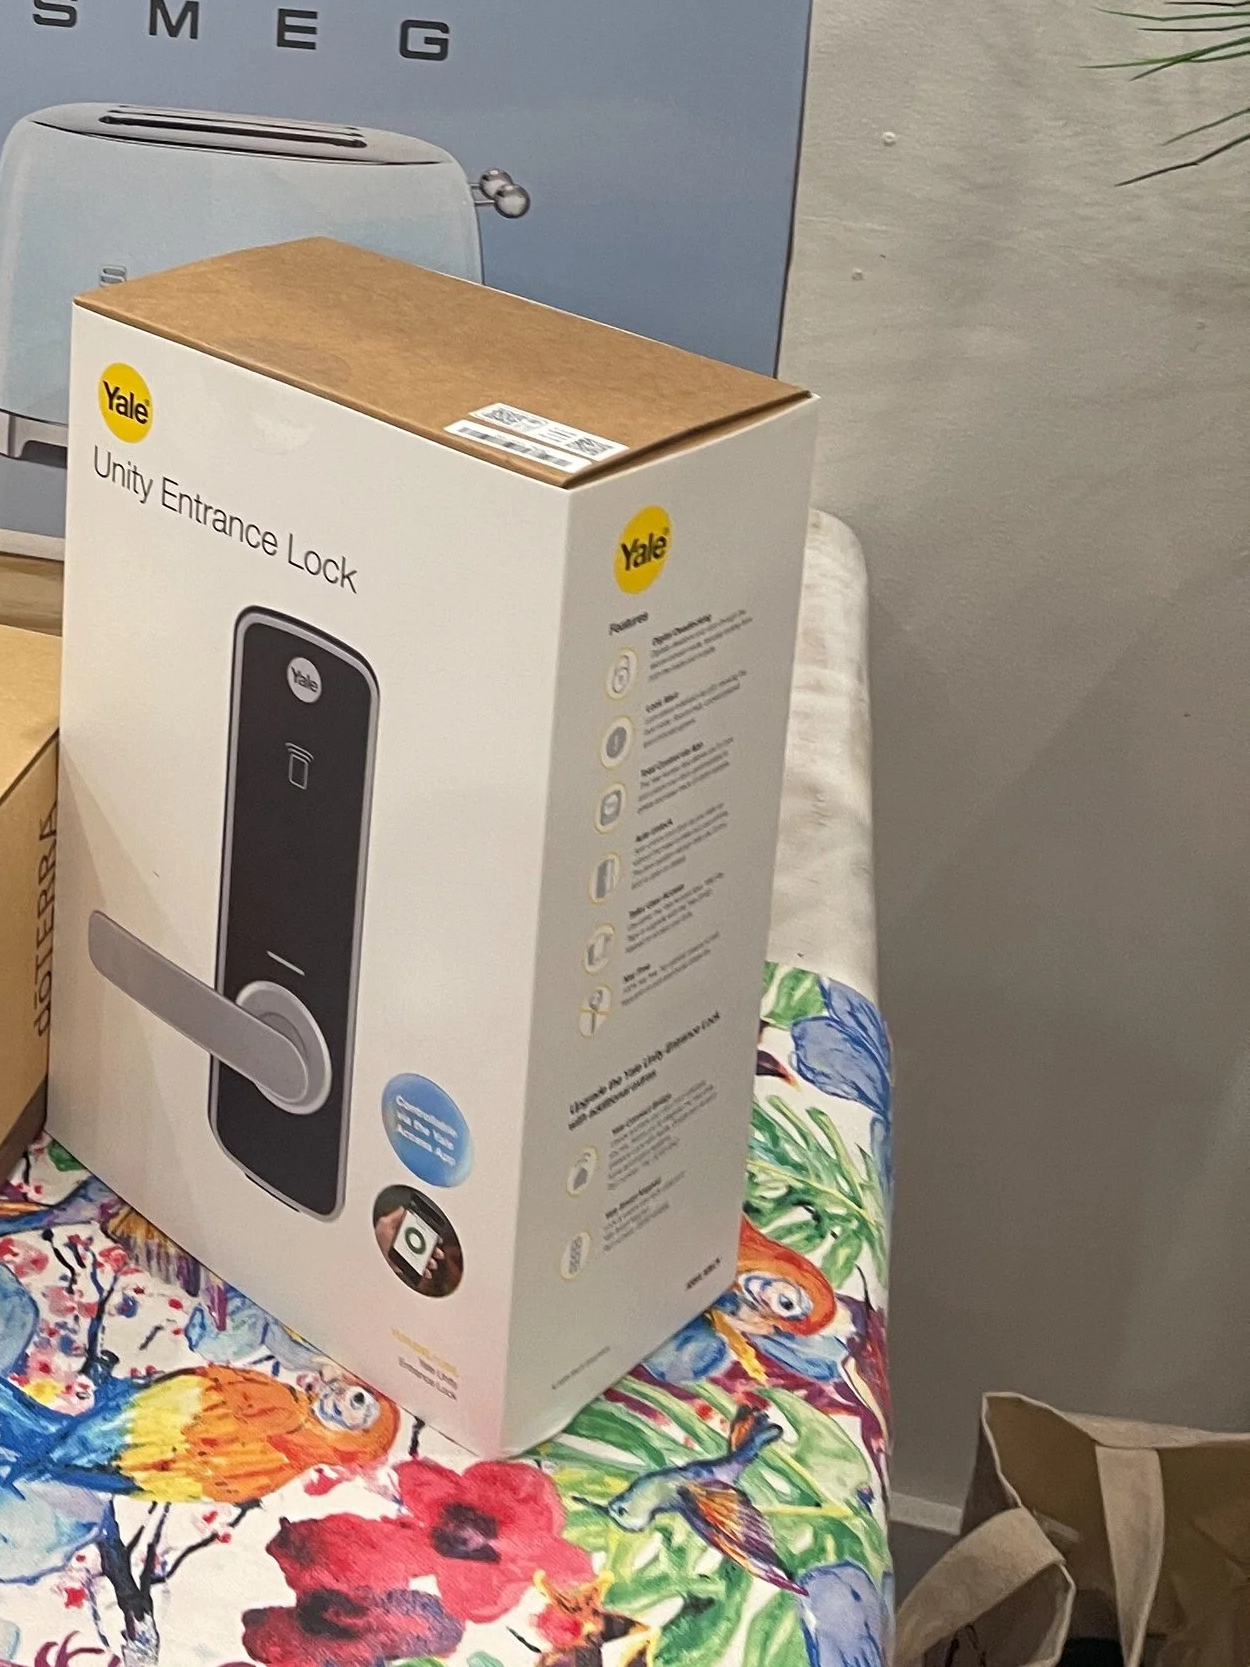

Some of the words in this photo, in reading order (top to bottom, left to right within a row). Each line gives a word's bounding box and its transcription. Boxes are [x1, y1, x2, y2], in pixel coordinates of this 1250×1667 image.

[102, 380, 150, 425] Yale
[94, 445, 153, 504] Unity
[161, 476, 279, 556] Entrance
[287, 533, 358, 594] Lock
[620, 532, 668, 572] Yale
[291, 666, 318, 693] Yale
